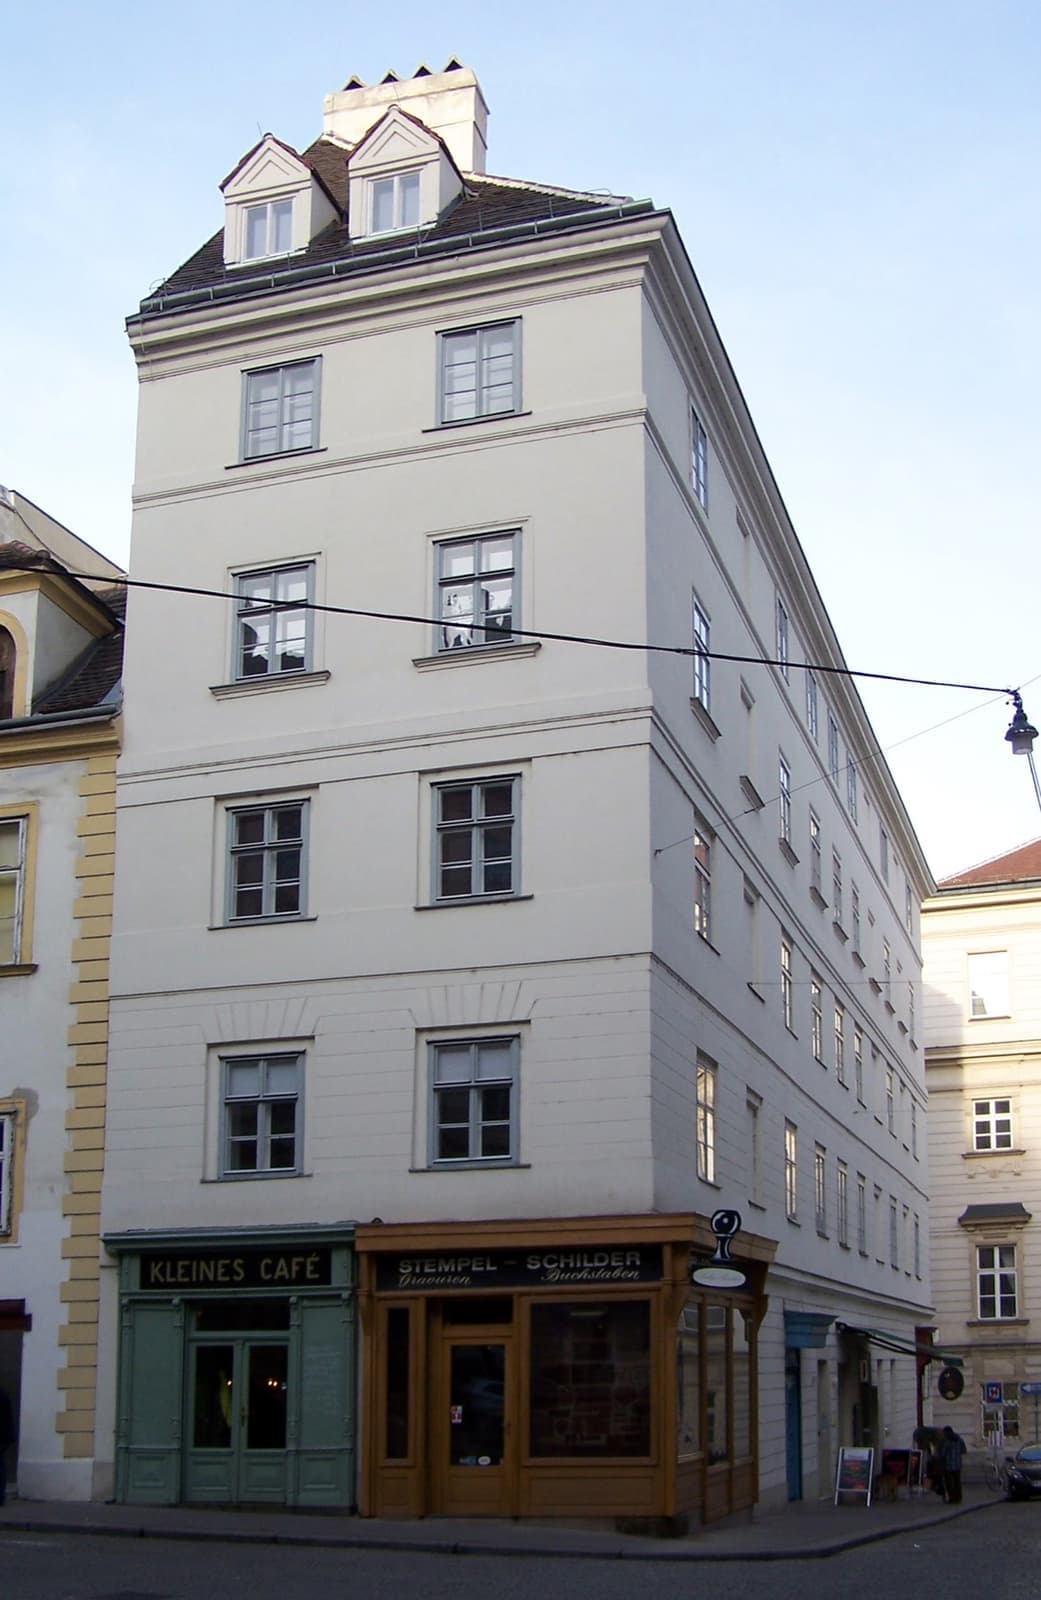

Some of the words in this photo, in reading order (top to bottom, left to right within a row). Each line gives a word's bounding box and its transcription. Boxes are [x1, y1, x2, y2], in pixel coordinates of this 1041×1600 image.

[149, 1258, 246, 1283] KLEINES
[259, 1252, 321, 1280] CAFÉ
[398, 1256, 498, 1274] STEMPEL
[526, 1250, 641, 1270] SCHILDER
[540, 1266, 641, 1282] Buchstaben
